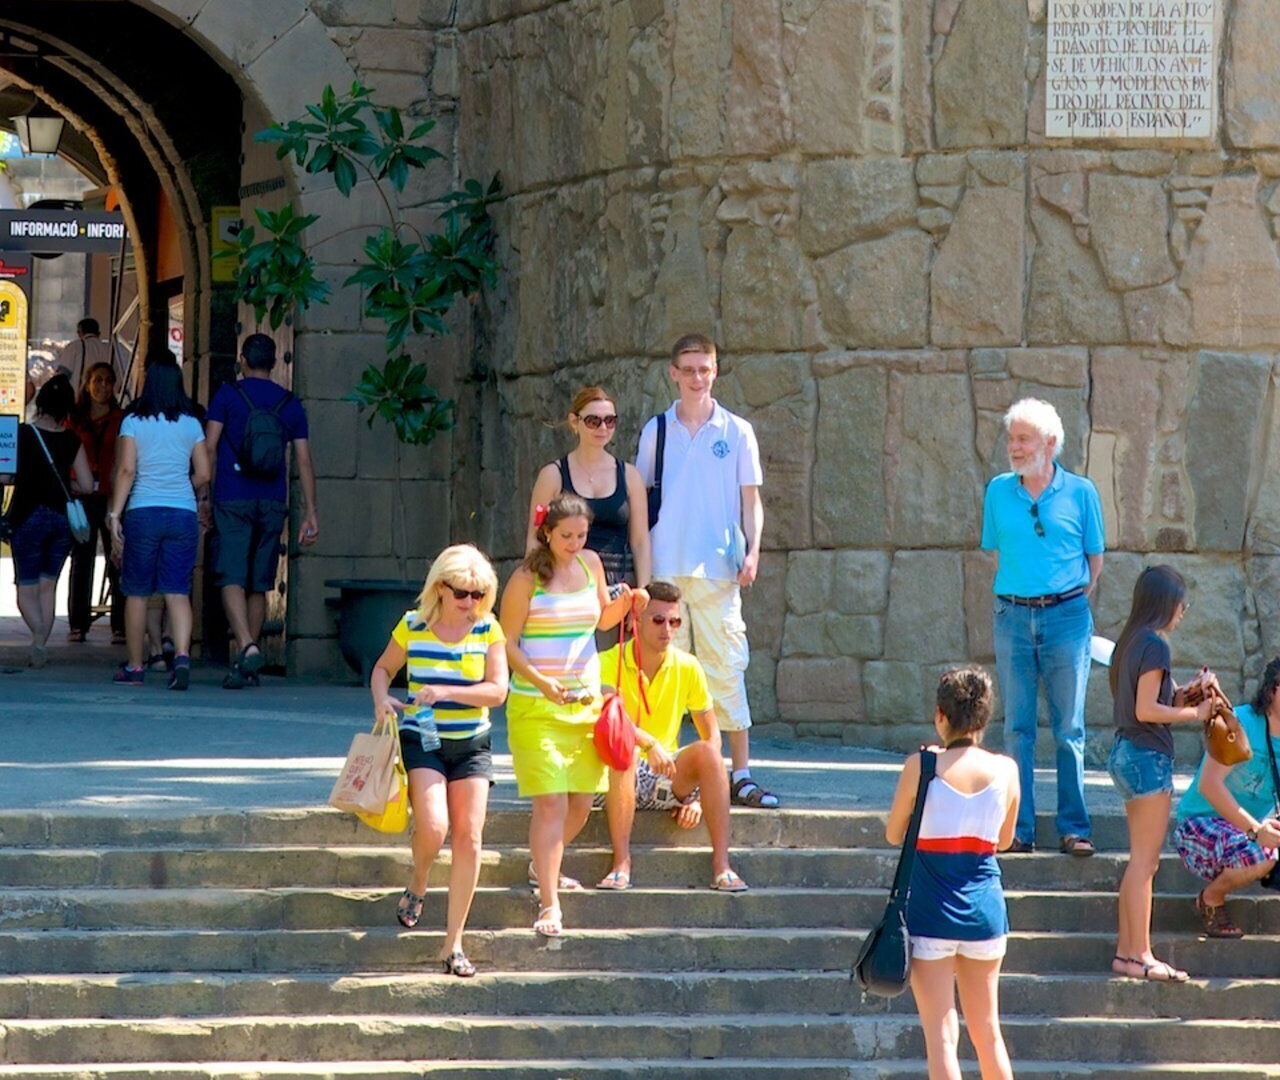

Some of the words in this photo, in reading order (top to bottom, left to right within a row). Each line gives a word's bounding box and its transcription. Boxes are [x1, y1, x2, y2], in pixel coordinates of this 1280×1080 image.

[1054, 3, 1080, 18] POR
[1130, 2, 1144, 17] DE
[1149, 2, 1165, 17] LA
[1053, 21, 1090, 37] RIDAD
[1095, 21, 1112, 36] SE
[1117, 20, 1176, 36] PROHIBE
[1184, 20, 1204, 36] EL
[1123, 38, 1138, 53] DE
[1143, 38, 1179, 54] TODA
[1051, 57, 1066, 73] SE
[1072, 57, 1086, 73] DE
[1053, 94, 1082, 110] TRO
[1086, 94, 1111, 110] DEL
[1116, 94, 1174, 110] RECINTO
[1180, 94, 1205, 110] DEL
[10, 220, 78, 237] INFORMACIÓ
